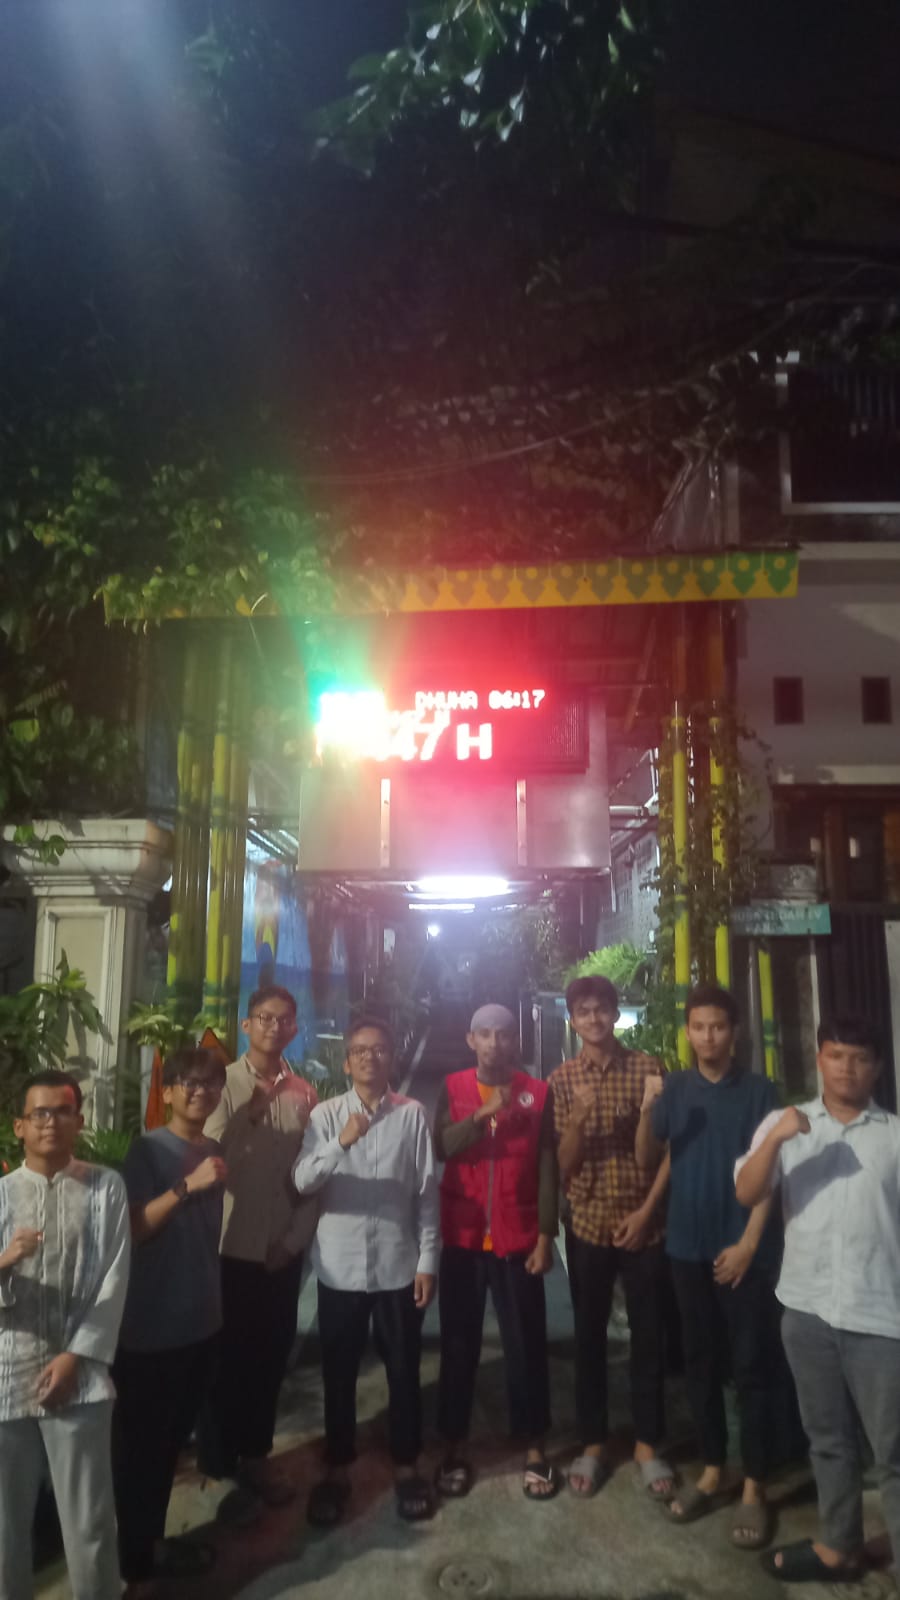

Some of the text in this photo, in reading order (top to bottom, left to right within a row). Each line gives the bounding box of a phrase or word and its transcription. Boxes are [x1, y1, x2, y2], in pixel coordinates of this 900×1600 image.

[415, 690, 545, 709] DHUHA 06:17
[456, 722, 492, 761] H
